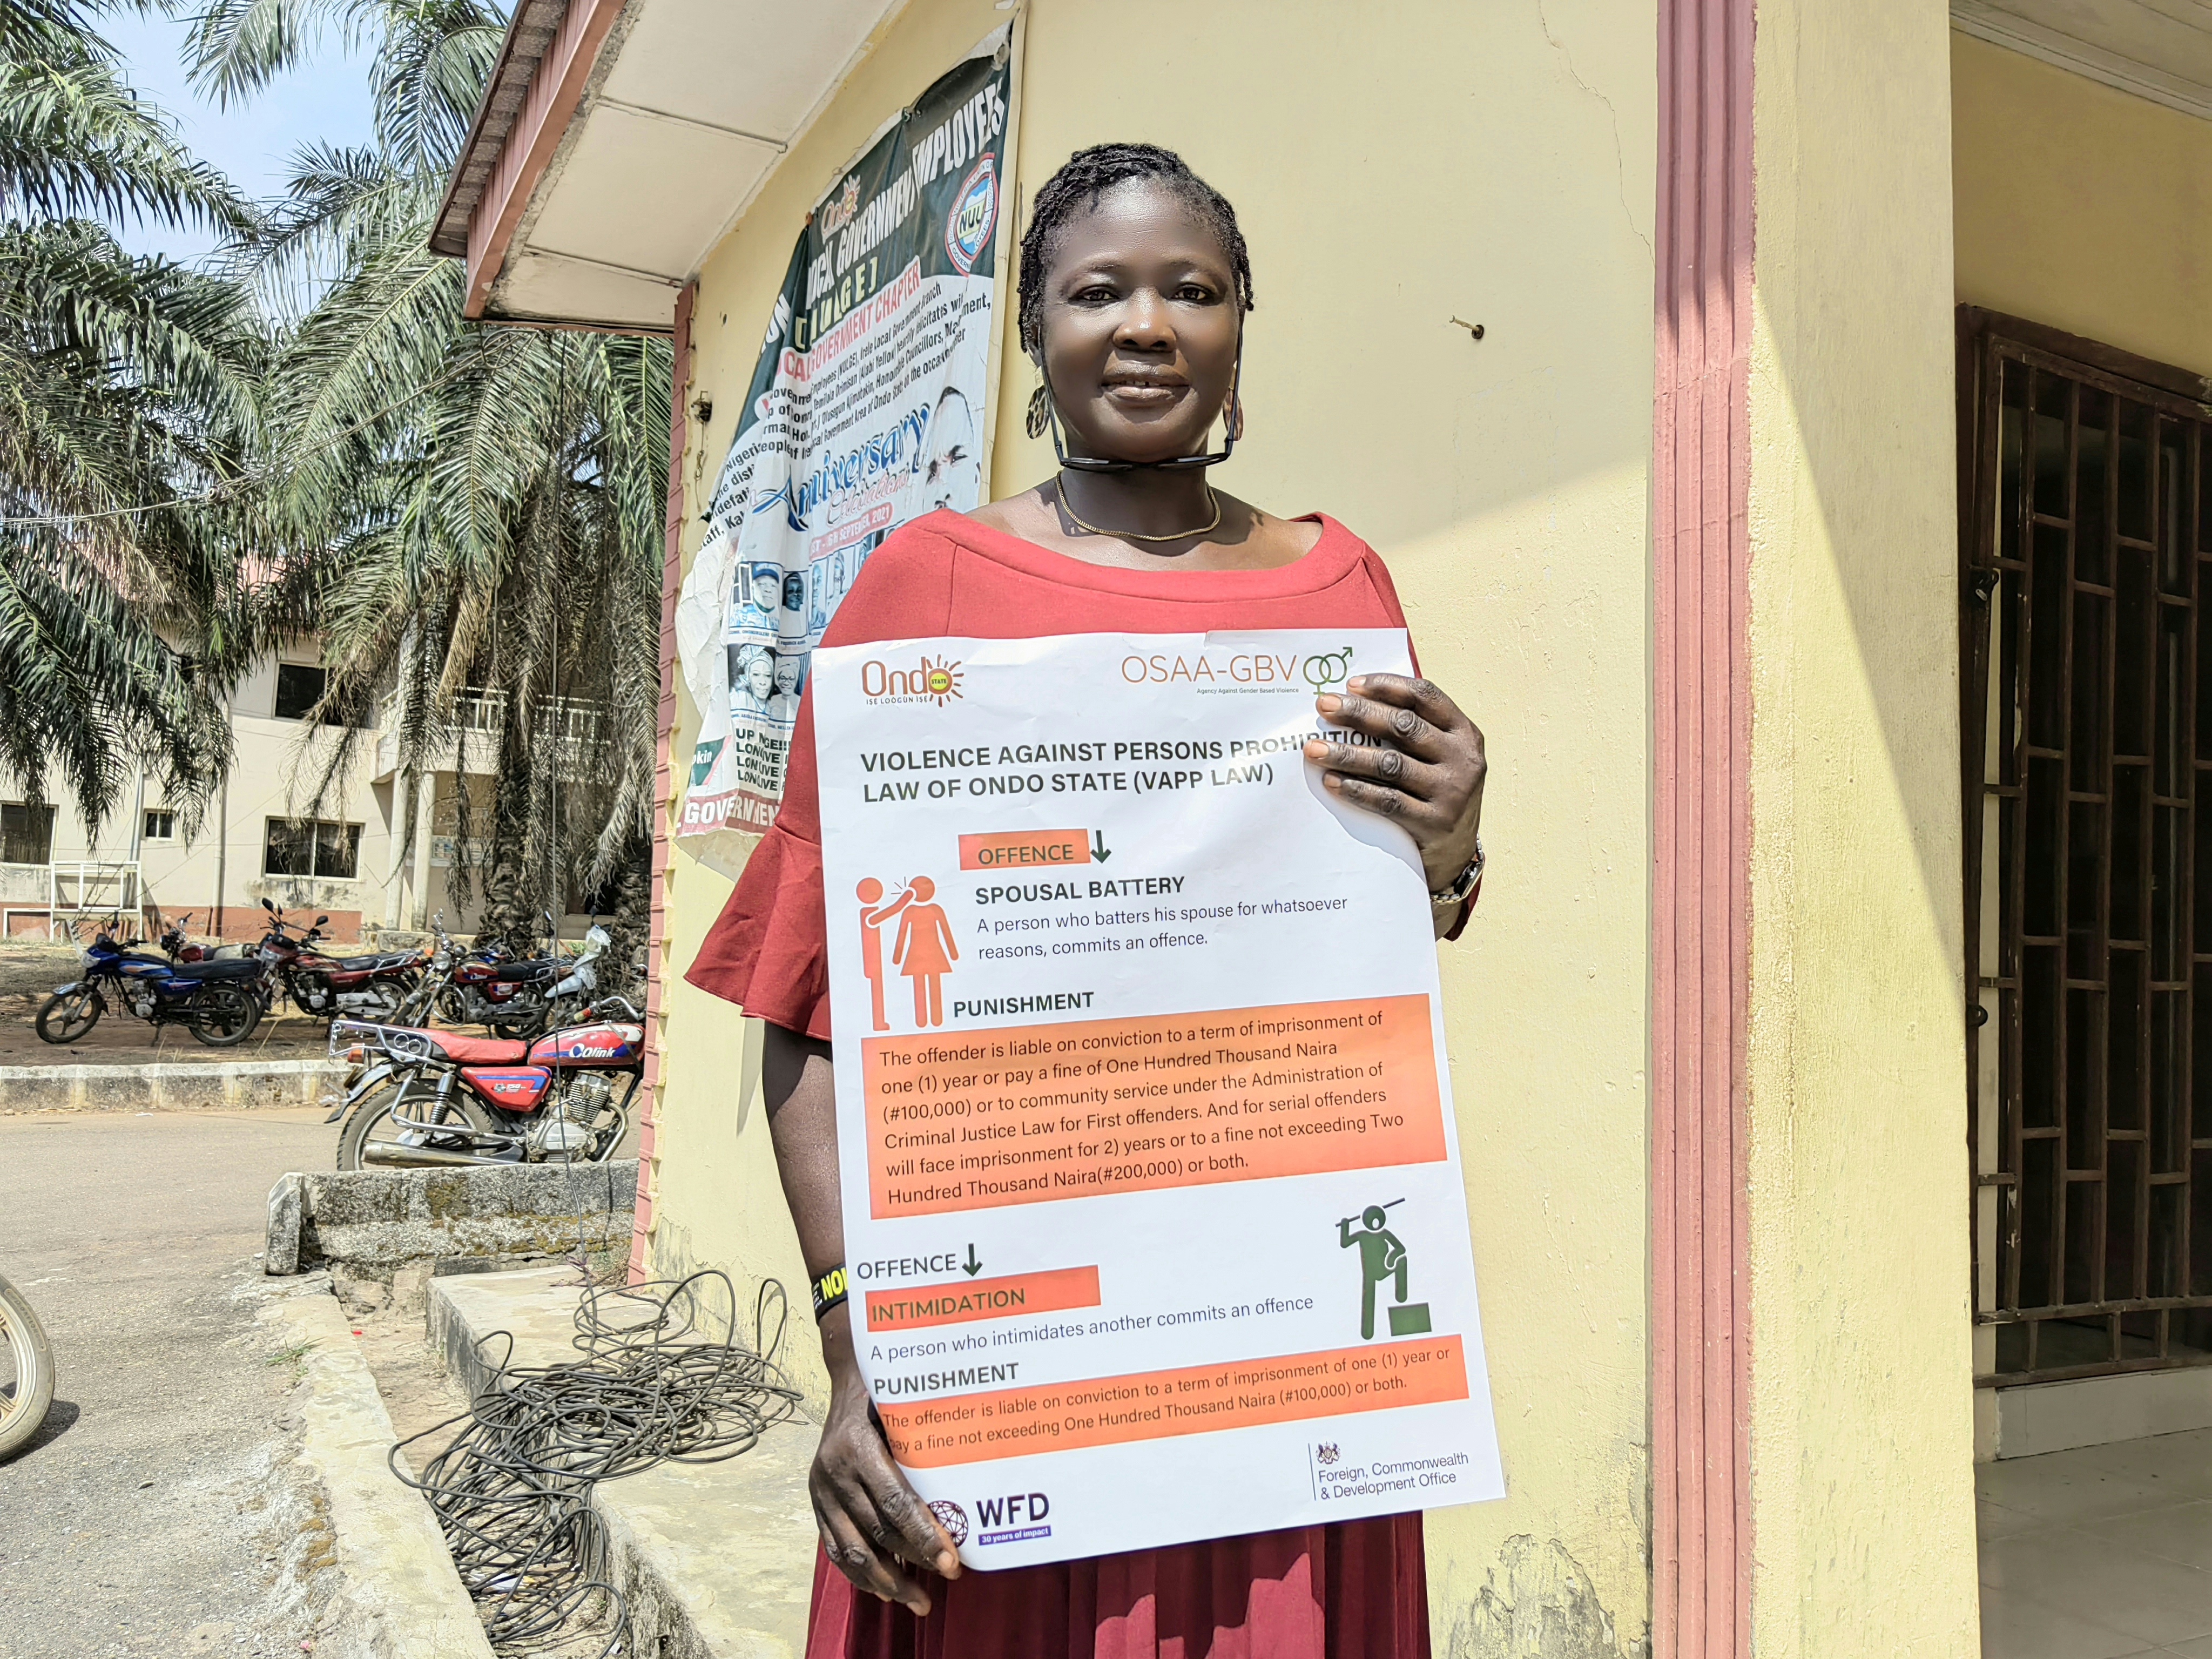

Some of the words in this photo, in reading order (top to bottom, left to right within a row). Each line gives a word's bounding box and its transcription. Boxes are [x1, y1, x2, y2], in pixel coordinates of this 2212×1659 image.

[875, 262, 920, 323] CHAPTER
[874, 328, 891, 348] Local
[874, 391, 891, 409] Ondo
[861, 656, 953, 697] Ondo
[1122, 655, 1297, 683] OSAA-GBV
[736, 728, 754, 740] UP
[860, 747, 990, 772] VIOLENCE
[998, 743, 1107, 764] AGAINST
[1114, 741, 1223, 760] PERSONS
[864, 781, 919, 802] LAW
[928, 779, 961, 798] OF
[969, 774, 1043, 796] ONDO
[1051, 772, 1127, 792] STATE
[1134, 771, 1203, 794] (VAPP
[1211, 763, 1273, 786] LAW)
[979, 845, 1074, 865] OFFENCE
[976, 882, 1082, 905] SPOUSAL
[1089, 876, 1185, 898] BATTERY
[977, 919, 989, 933] A
[995, 918, 1050, 935] person
[1055, 912, 1089, 927] who
[1095, 911, 1150, 925] batters
[1155, 907, 1176, 921] his
[1181, 907, 1233, 923] spouse
[1237, 901, 1257, 916] for
[1261, 899, 1347, 914] whatsoever
[979, 945, 1047, 959] reasons,
[1053, 937, 1121, 954] commits
[1126, 939, 1144, 950] an
[1150, 932, 1208, 948] offence.
[954, 992, 1094, 1017] PUNISHMENT
[879, 1050, 911, 1067] The
[918, 1044, 986, 1063] offender
[992, 1043, 1004, 1057] is
[1010, 1038, 1051, 1056] liable
[1057, 1040, 1076, 1051] on
[1082, 1030, 1162, 1049] conviction
[1167, 1029, 1182, 1042] to
[1187, 1030, 1195, 1041] a
[1200, 1027, 1235, 1040] term
[1240, 1021, 1253, 1036] of
[1258, 1014, 1364, 1036] imprisonment
[1368, 1010, 1382, 1026] of
[882, 1081, 913, 1094] one
[919, 1075, 937, 1094] (1)
[942, 1075, 978, 1092] year
[983, 1073, 1000, 1085] or
[1006, 1070, 1033, 1087] pay
[1039, 1069, 1047, 1080] a
[1053, 1063, 1082, 1078] fine
[1087, 1060, 1102, 1075] of
[1107, 1059, 1138, 1073] One
[1144, 1050, 1211, 1070] Hundred
[1216, 1043, 1291, 1063] Thousand
[1297, 1041, 1337, 1057] Naira
[884, 1099, 971, 1125] (#100,000)
[977, 1101, 993, 1112] or
[998, 1097, 1014, 1110] to
[1020, 1087, 1108, 1109] community
[1114, 1082, 1168, 1100] service
[1174, 1077, 1217, 1094] under
[1221, 1074, 1246, 1089] the
[1252, 1065, 1364, 1087] Administration
[1369, 1061, 1382, 1076] of
[885, 1127, 955, 1149] Criminal
[961, 1123, 1016, 1142] Justice
[1022, 1121, 1055, 1136] Law
[1060, 1116, 1081, 1132] for
[1087, 1112, 1121, 1129] First
[1127, 1105, 1202, 1125] offenders.
[1207, 1100, 1238, 1117] And
[1243, 1099, 1264, 1114] for
[1269, 1094, 1310, 1111] serial
[1315, 1089, 1386, 1107] offenders
[886, 1159, 914, 1177] will
[920, 1158, 954, 1174] face
[960, 1144, 1073, 1171] imprisonment
[1077, 1142, 1099, 1157] for
[1104, 1138, 1118, 1156] 2)
[1123, 1138, 1165, 1156] years
[1170, 1135, 1185, 1147] or
[1190, 1132, 1206, 1145] to
[1211, 1132, 1219, 1143] a
[1224, 1127, 1253, 1142] fine
[1259, 1124, 1284, 1139] not
[1289, 1116, 1366, 1136] exceeding
[1370, 1114, 1403, 1128] Two
[888, 1182, 961, 1204] Hundred
[967, 1172, 1048, 1196] Thousand
[1055, 1158, 1182, 1186] Naira(#200,000)
[1188, 1161, 1204, 1172] or
[1209, 1153, 1248, 1170] both.
[857, 1253, 957, 1279] OFFENCE
[872, 1287, 1026, 1322] INTIMIDATION
[871, 1345, 882, 1360] A
[889, 1342, 946, 1363] person
[952, 1334, 987, 1351] who
[993, 1324, 1084, 1346] intimidates
[1089, 1314, 1152, 1334] another
[1157, 1305, 1226, 1326] commits
[1231, 1305, 1250, 1317] an
[1256, 1298, 1313, 1314] offence
[874, 1363, 1019, 1394] PUNISHMENT
[914, 1440, 922, 1451] a
[927, 1434, 954, 1449] fine
[959, 1430, 982, 1445] not
[987, 1420, 1060, 1441] exceeding
[1064, 1417, 1094, 1431] One
[1099, 1405, 1161, 1426] Hundred
[1164, 1396, 1234, 1418] Thousand
[1239, 1393, 1275, 1408] Naira
[1280, 1381, 1351, 1406] (#100,000)
[1355, 1383, 1368, 1393] or
[1373, 1375, 1407, 1391] both.
[1319, 1467, 1368, 1483] Foreign,
[1372, 1452, 1468, 1475] Commonwealth
[1321, 1487, 1330, 1500] &
[1333, 1476, 1415, 1498] Development
[1419, 1472, 1456, 1487] Office
[976, 1493, 1049, 1528] WFD
[993, 1533, 1013, 1543] years
[1014, 1530, 1022, 1539] of
[1023, 1527, 1048, 1538] impact
